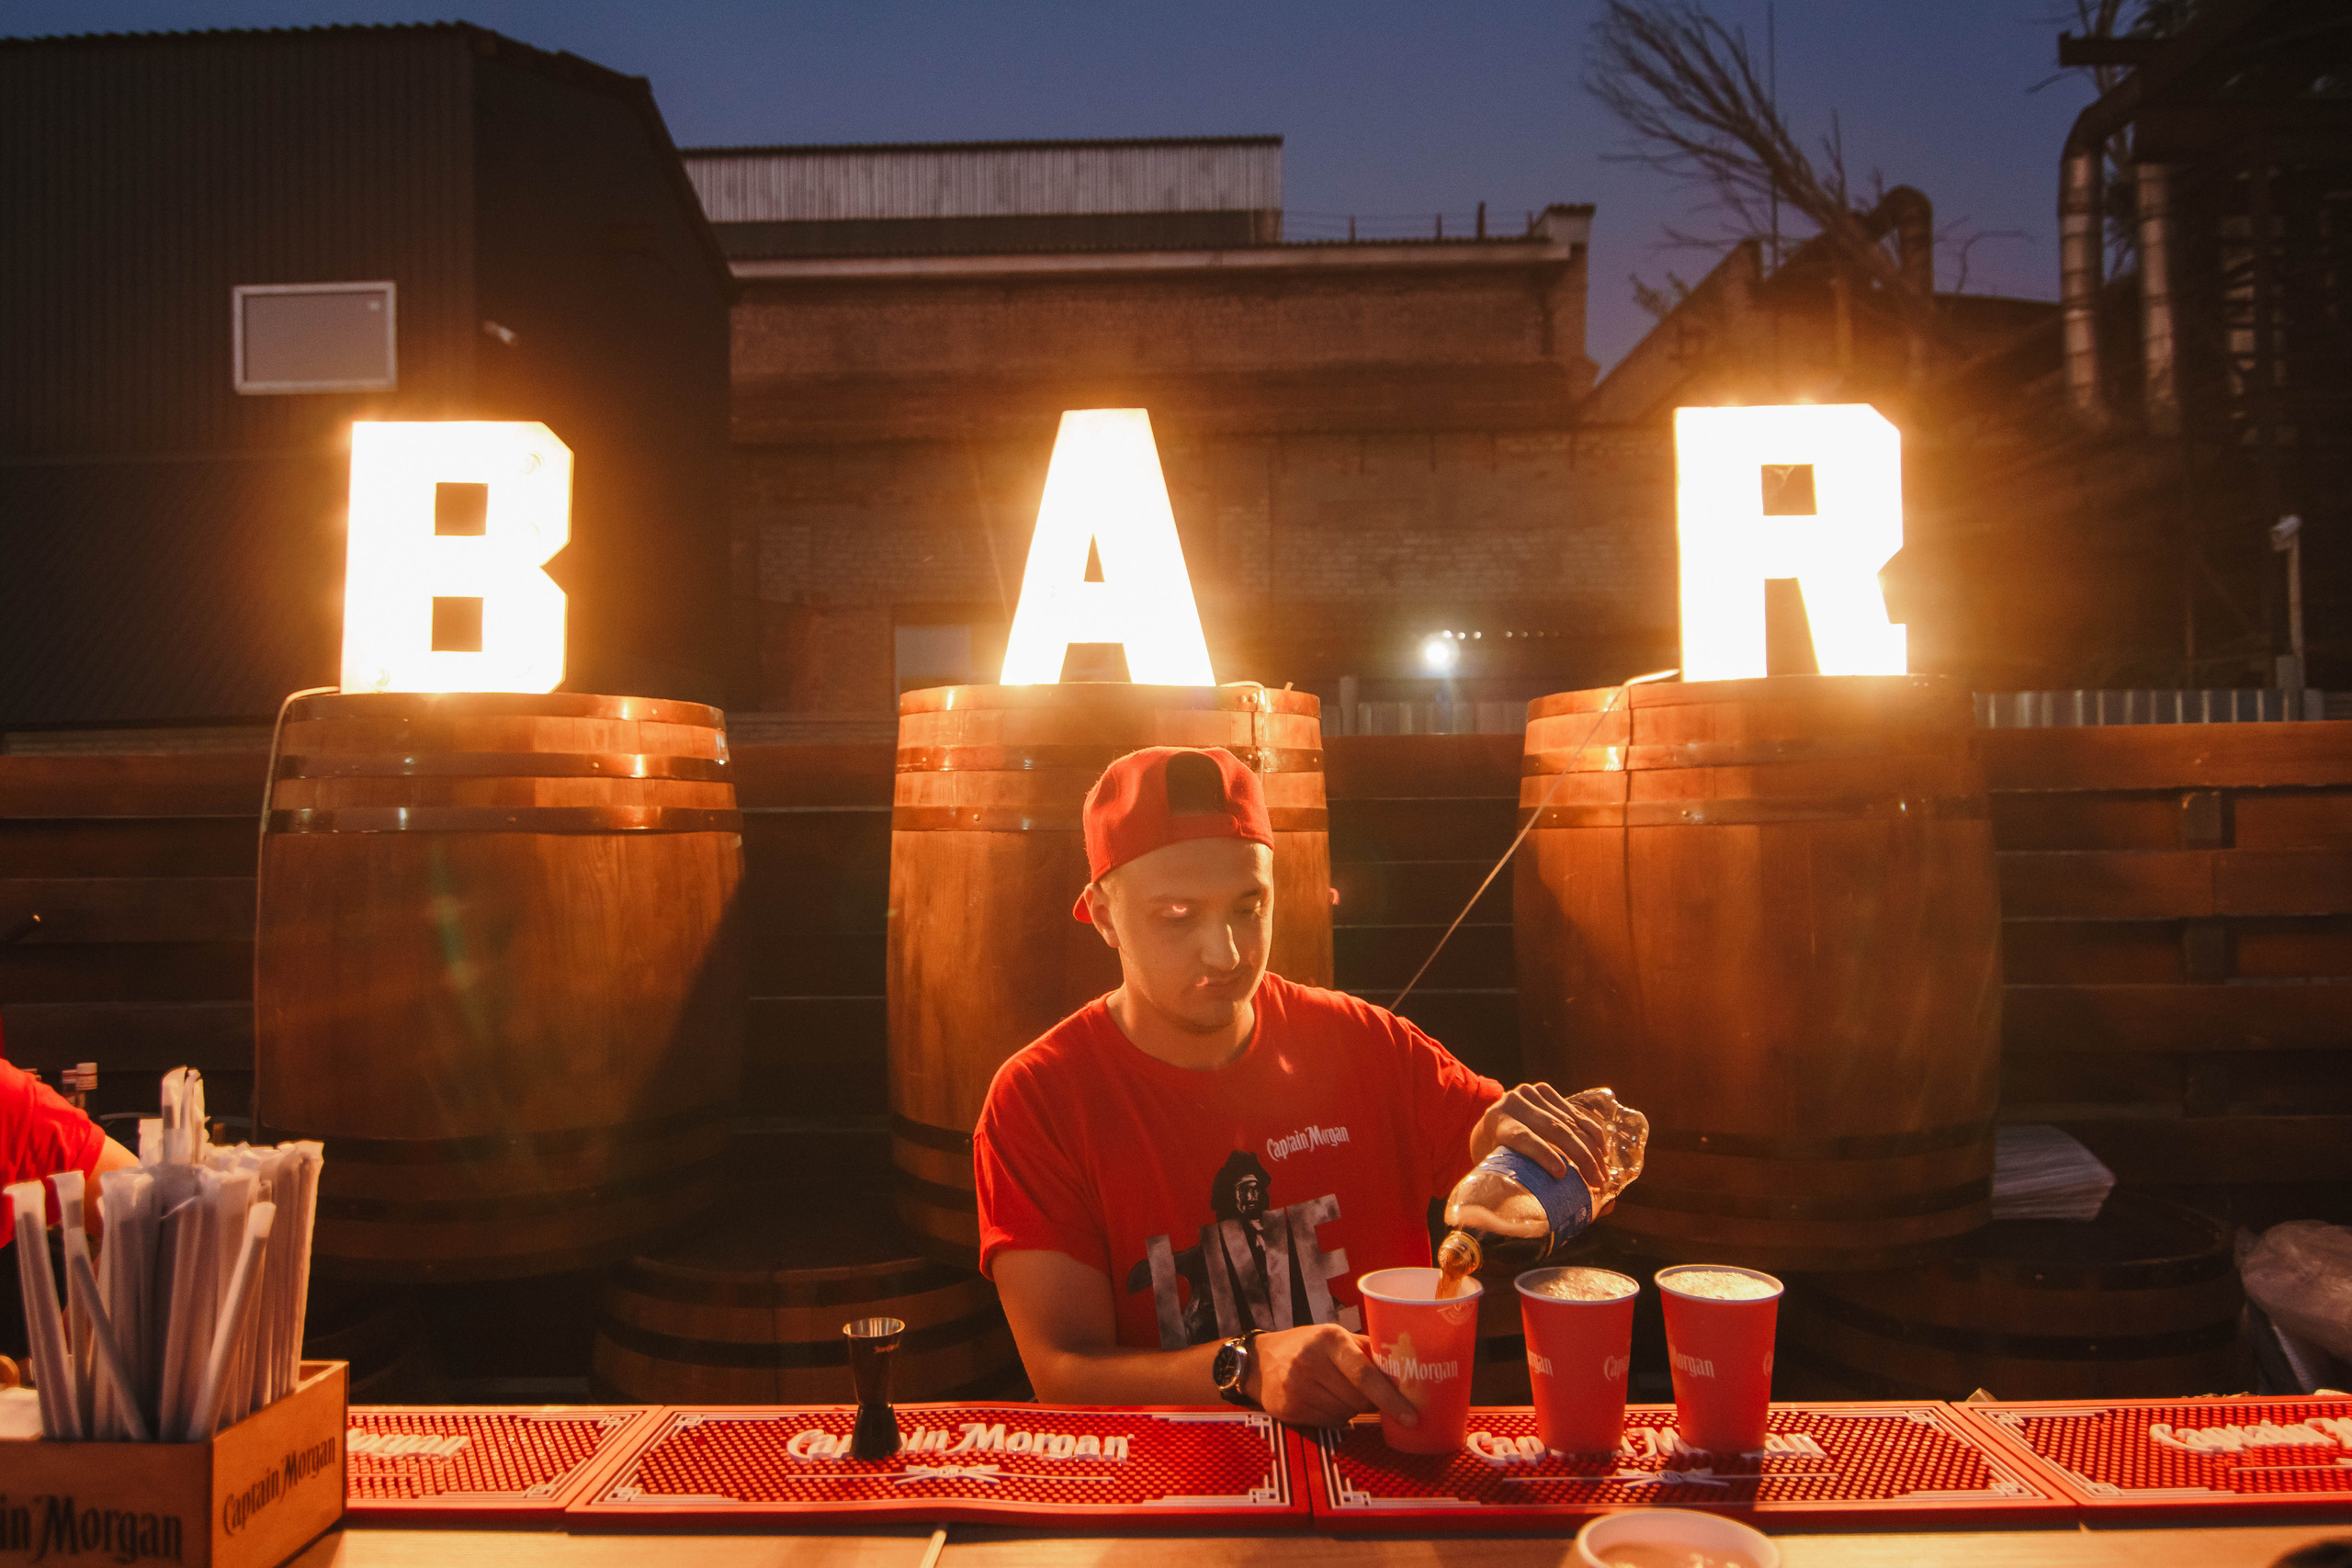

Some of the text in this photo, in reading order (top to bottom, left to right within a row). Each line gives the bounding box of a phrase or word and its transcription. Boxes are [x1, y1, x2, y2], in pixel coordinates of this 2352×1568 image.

[341, 403, 1907, 694] BAR
[1267, 1125, 1350, 1162] Captain Morgan
[1400, 1357, 1459, 1383] Morgan
[944, 1423, 1129, 1462] Morgan
[2149, 1419, 2339, 1455] Captain
[222, 1436, 336, 1537] Captain Morgan
[29, 1490, 183, 1565] Morgan
